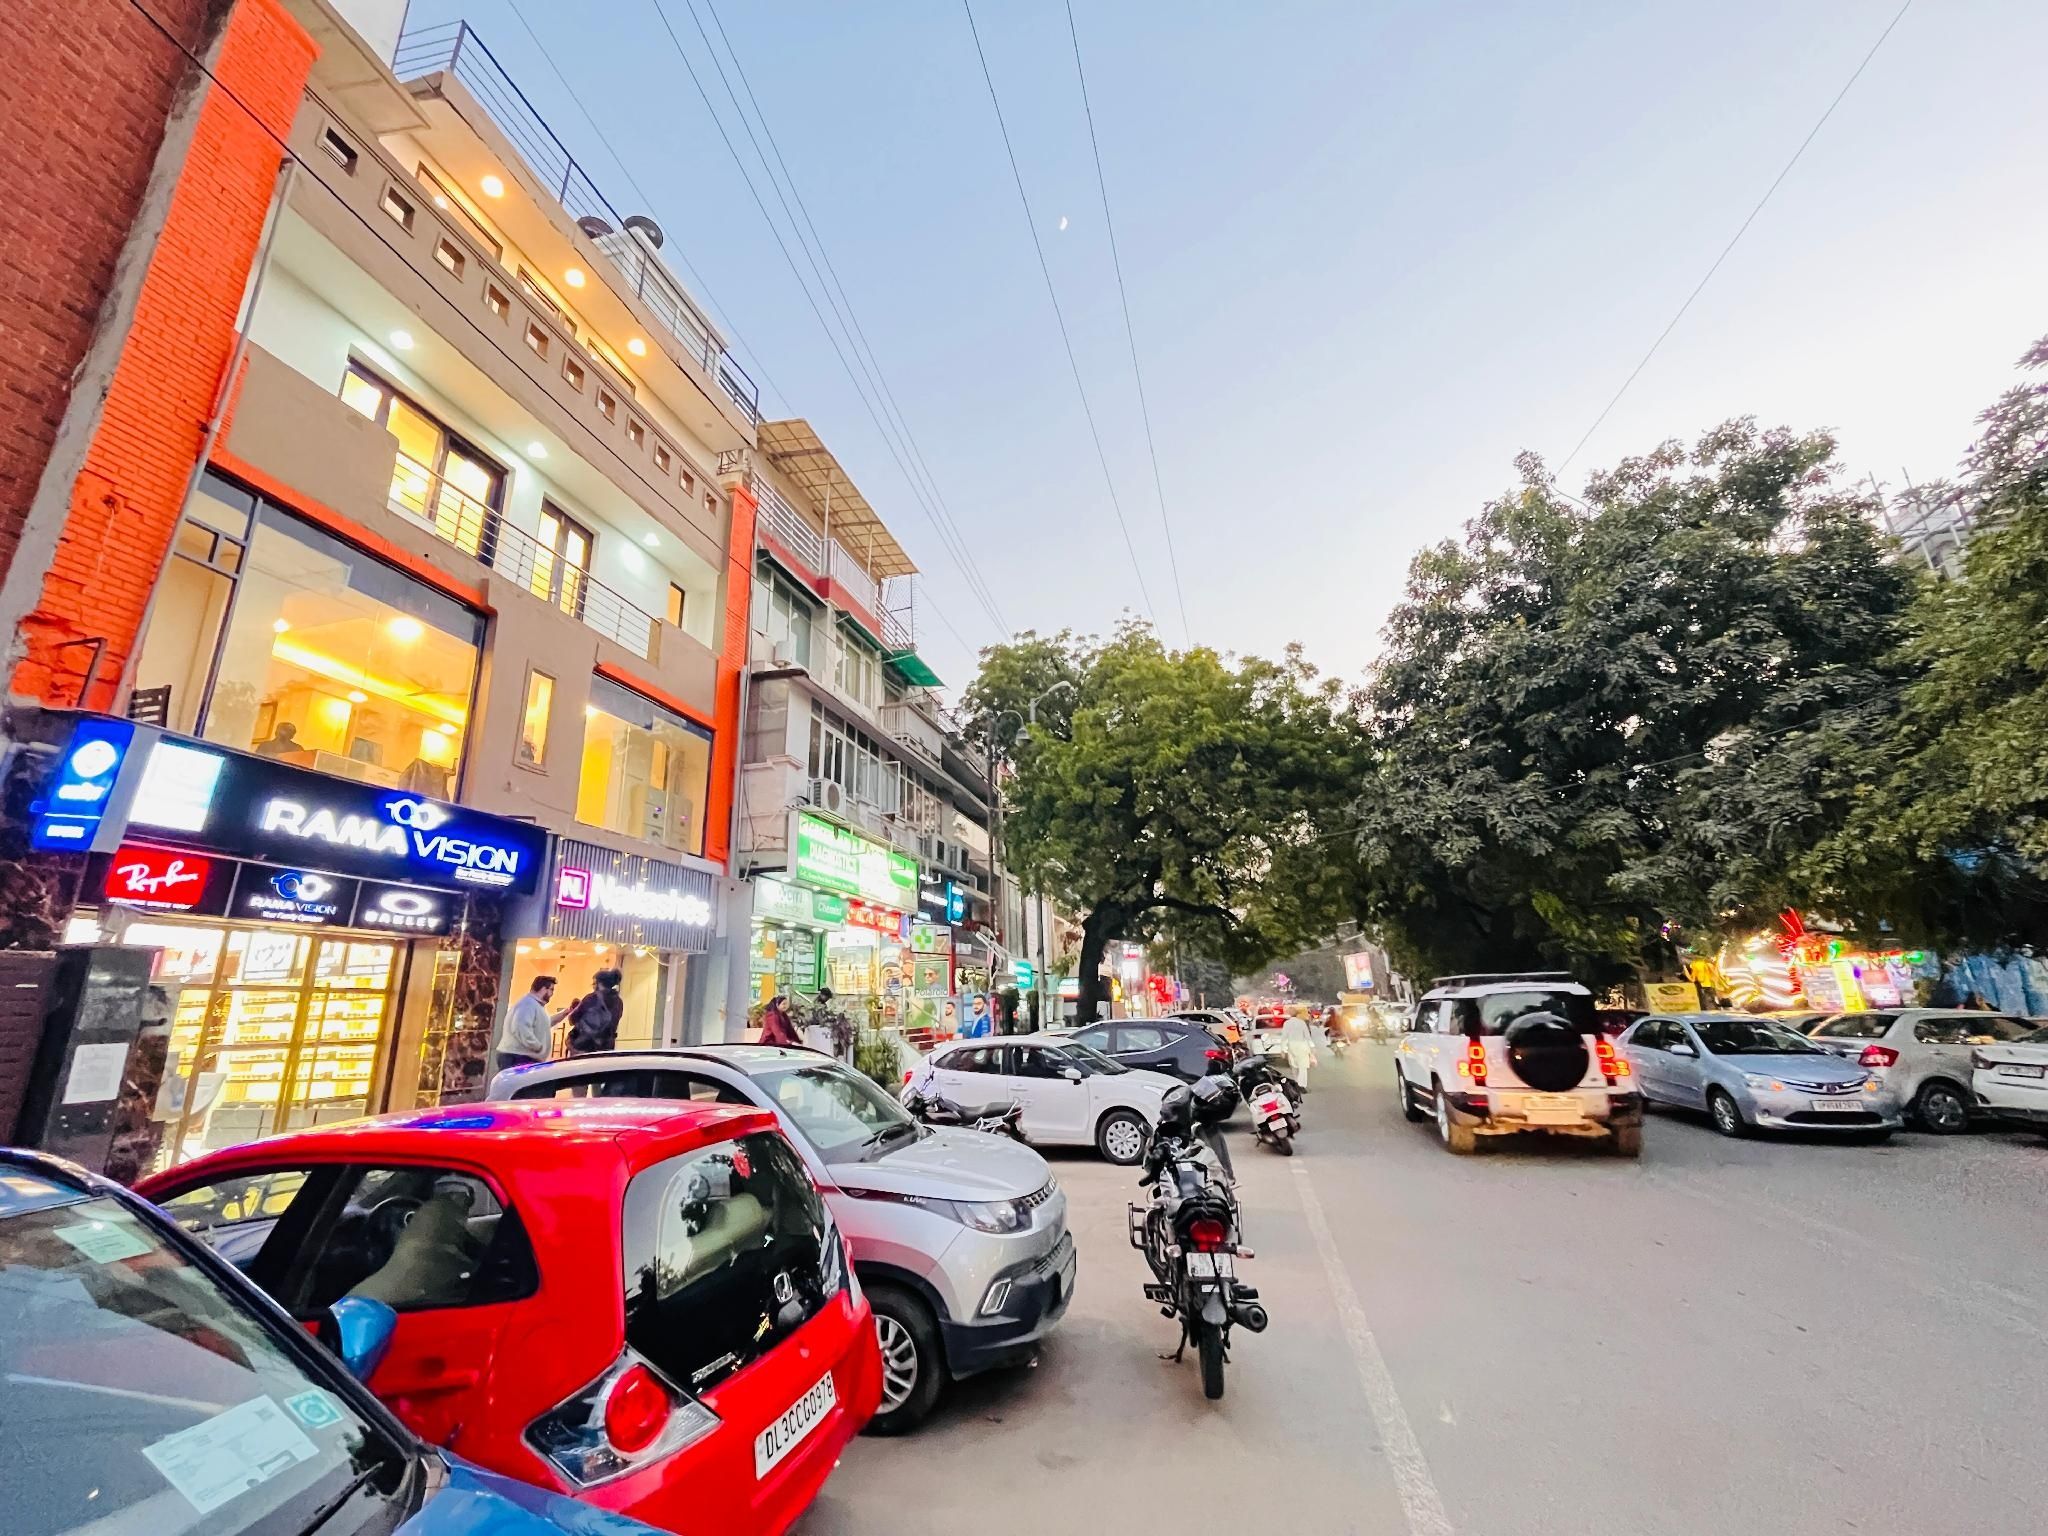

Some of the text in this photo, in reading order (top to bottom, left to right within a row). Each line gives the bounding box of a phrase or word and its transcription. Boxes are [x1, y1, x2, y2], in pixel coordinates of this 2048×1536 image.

[263, 800, 519, 873] RAMA VISION
[250, 895, 337, 915] RAMA VISION
[765, 1375, 833, 1459] DL3CCG0978
